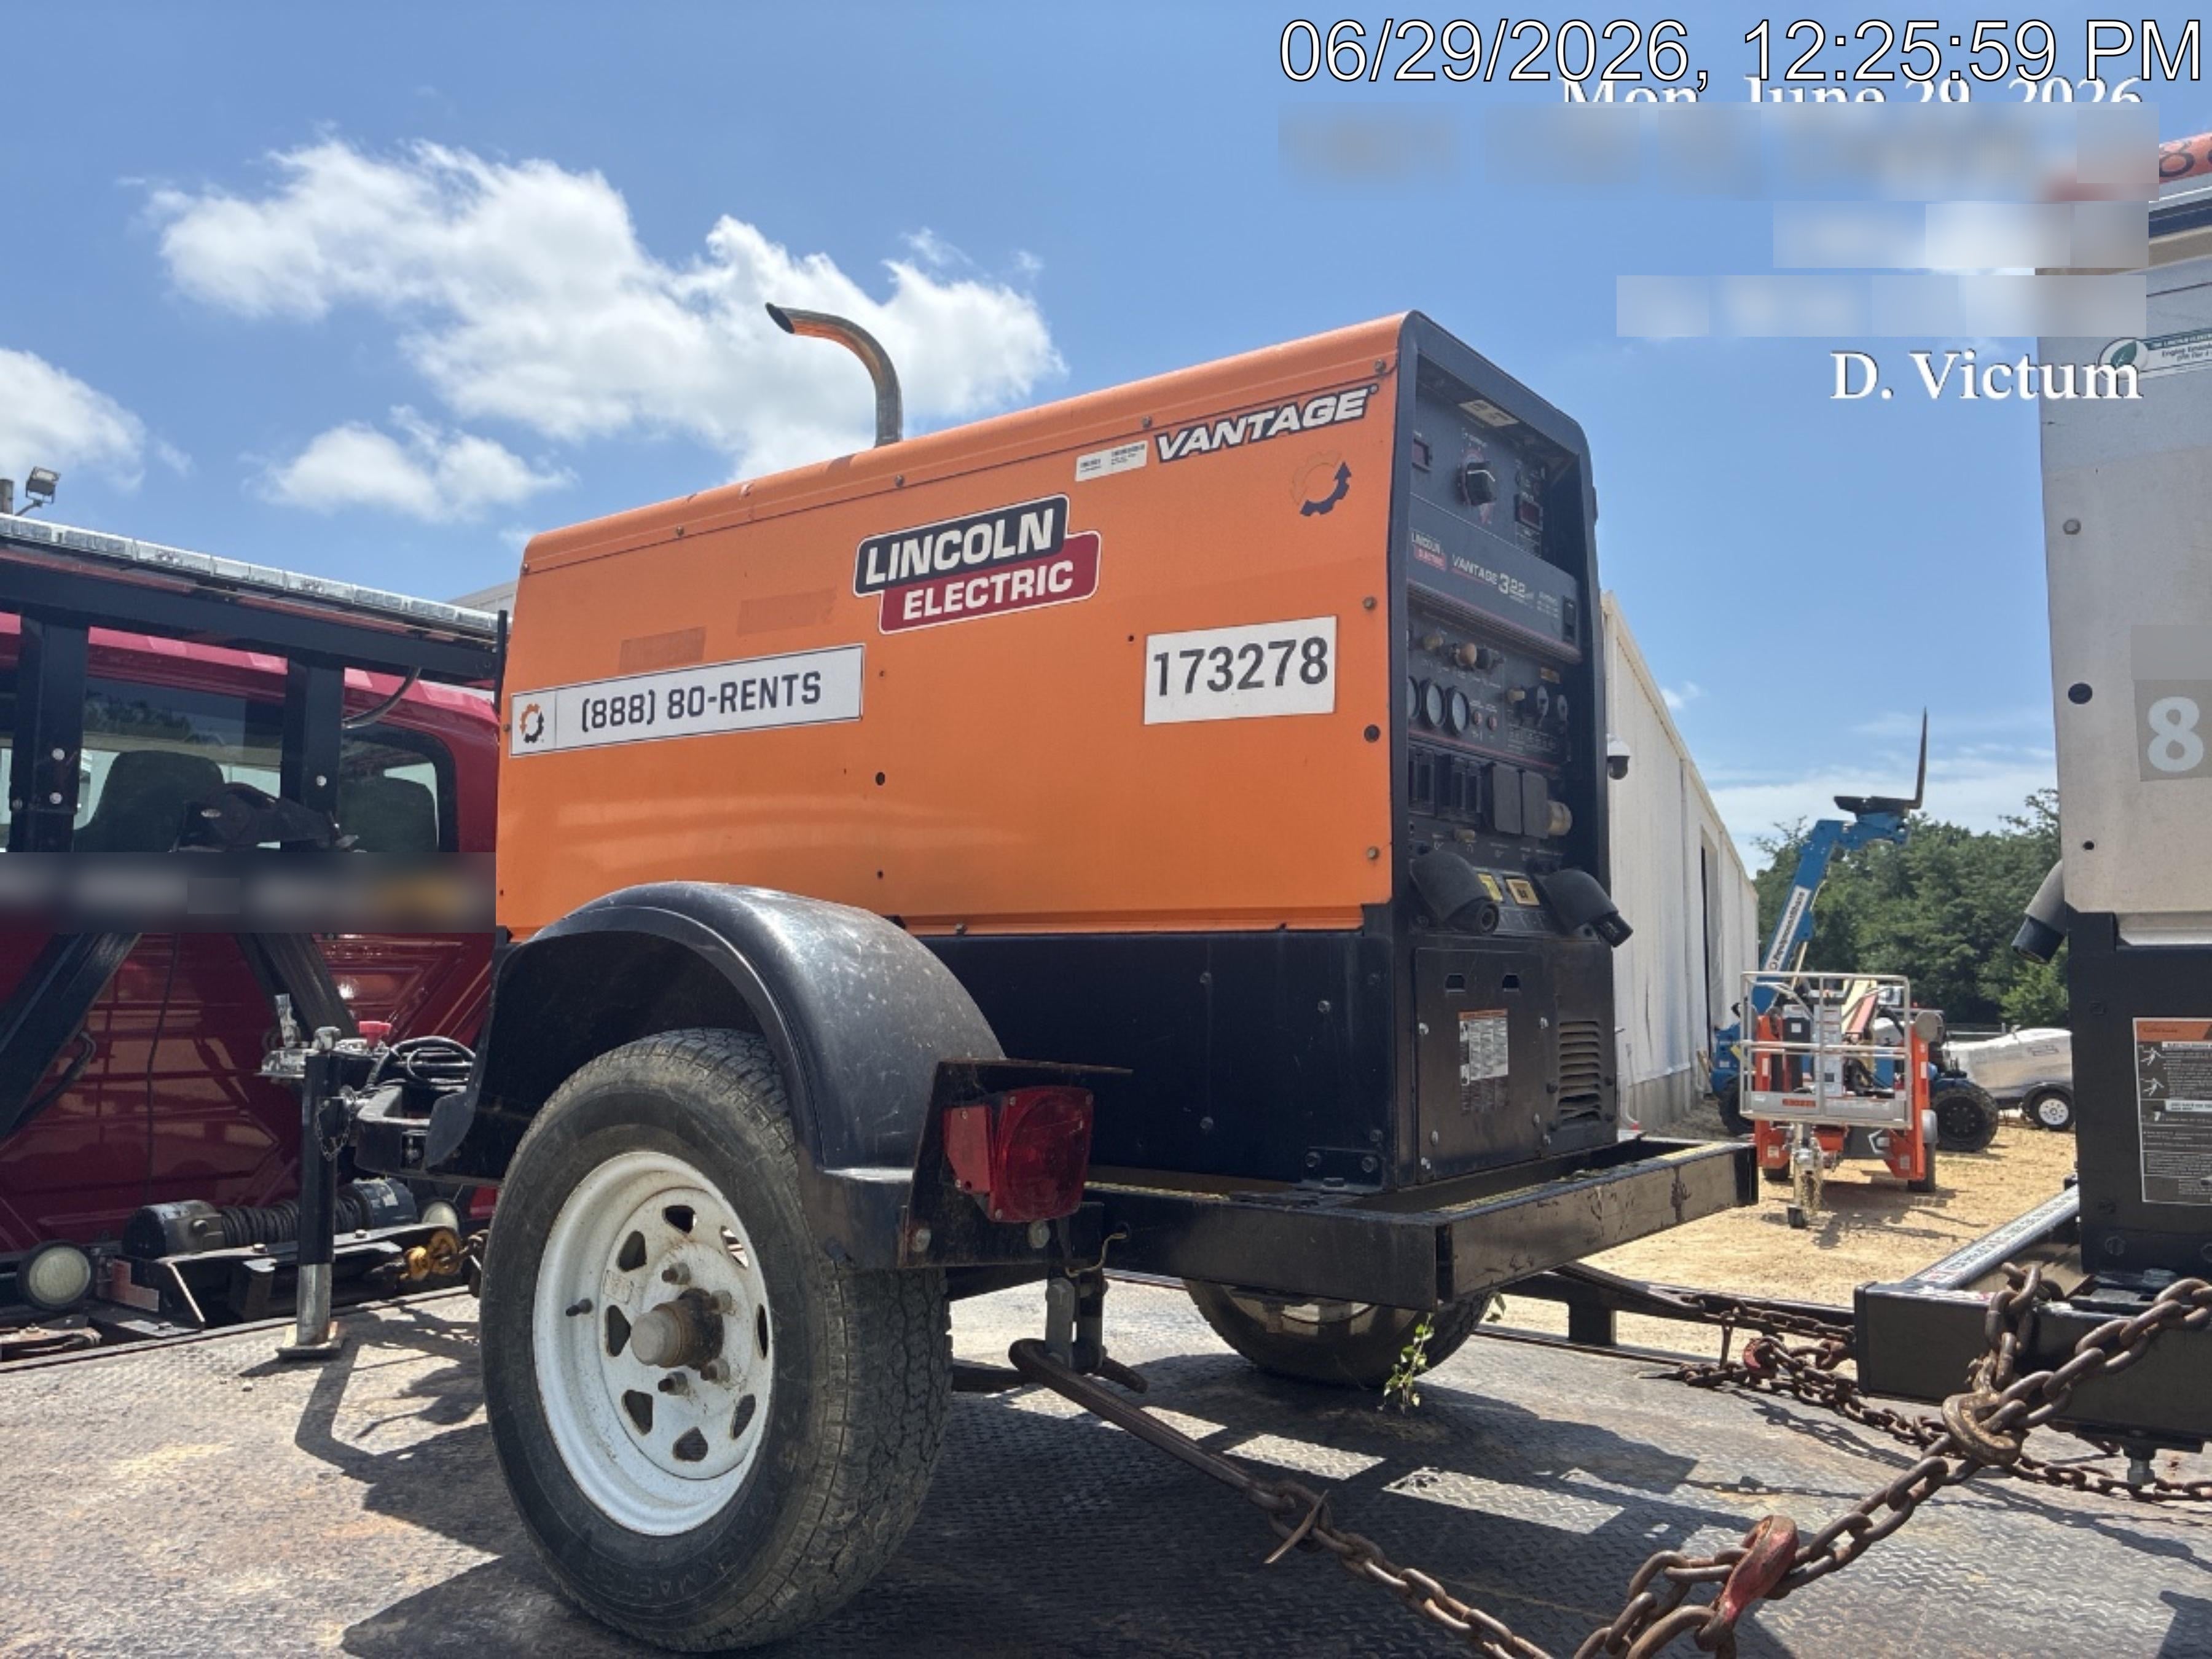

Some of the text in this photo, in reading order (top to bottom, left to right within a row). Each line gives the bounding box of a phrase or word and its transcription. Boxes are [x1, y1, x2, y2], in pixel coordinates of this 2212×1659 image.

[1155, 387, 1370, 461] VANTAGE
[865, 508, 1054, 586] LINCOLN
[903, 560, 1074, 621] ELECTRIC
[1153, 636, 1328, 697] 173278
[581, 670, 822, 732] (888) 80-RENTS
